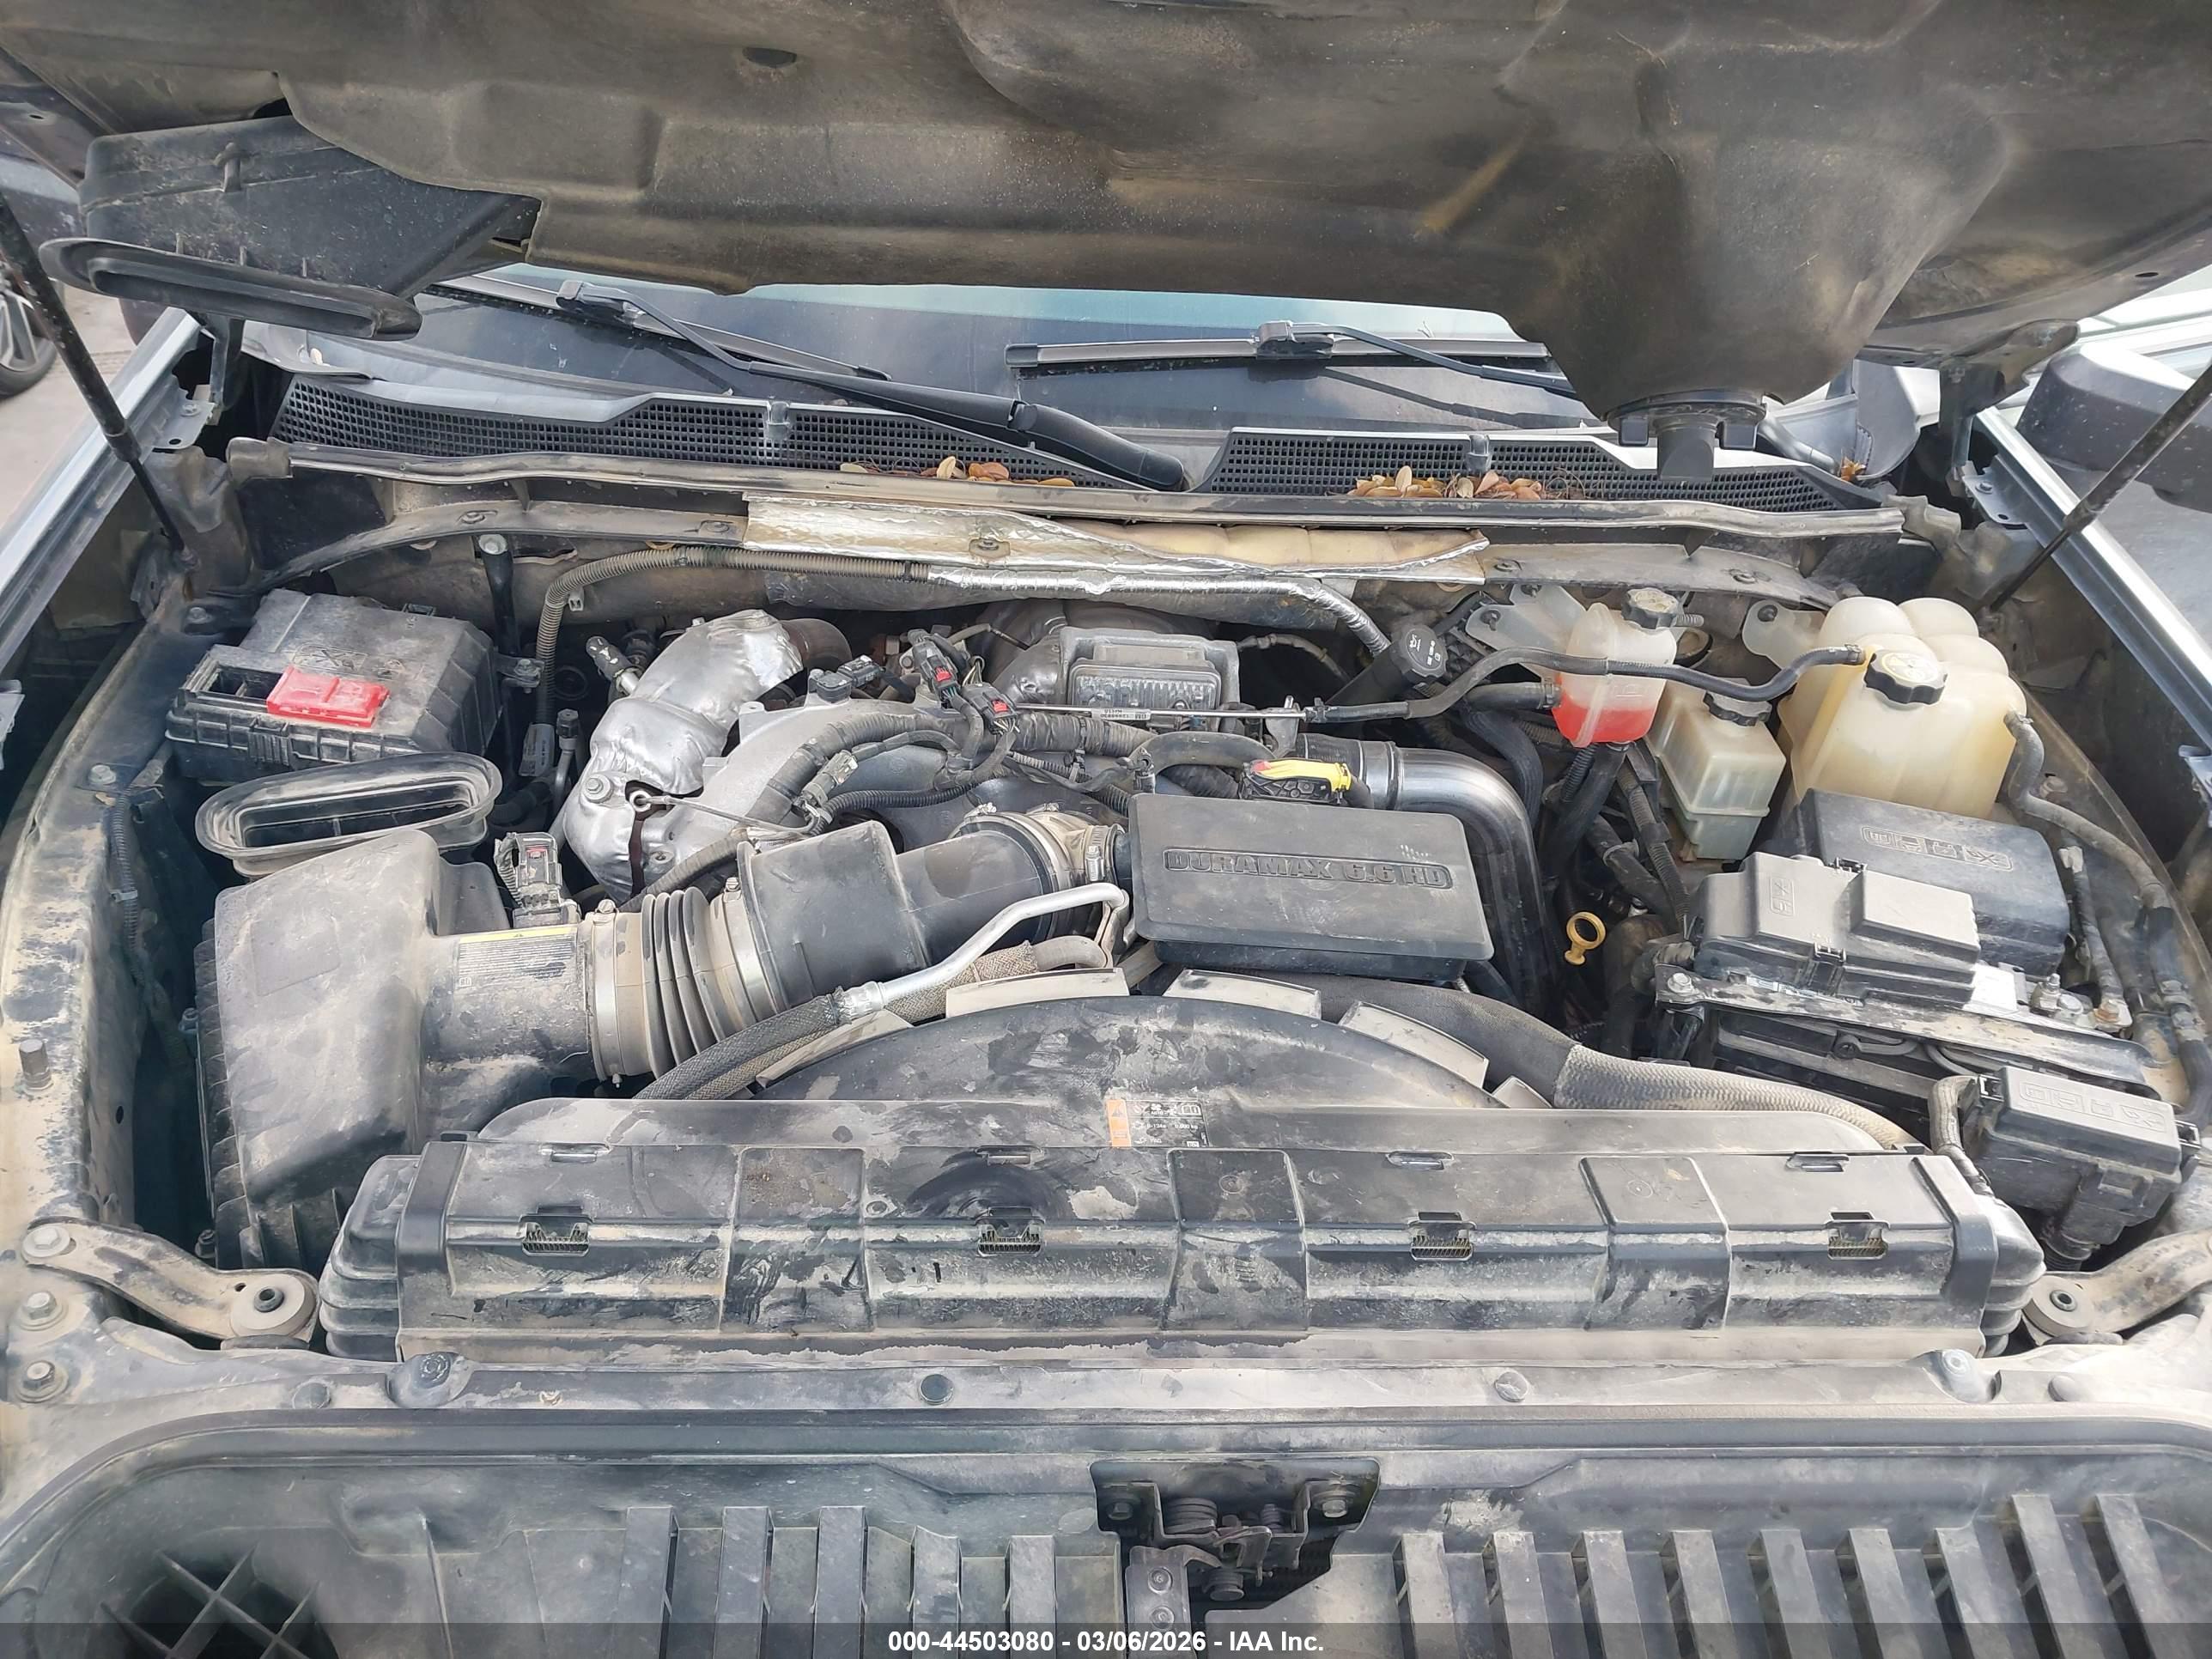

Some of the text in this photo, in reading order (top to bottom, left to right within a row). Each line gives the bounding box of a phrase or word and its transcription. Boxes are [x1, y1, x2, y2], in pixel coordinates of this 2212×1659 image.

[1169, 851, 1448, 887] DURAMAX 6.6 HD
